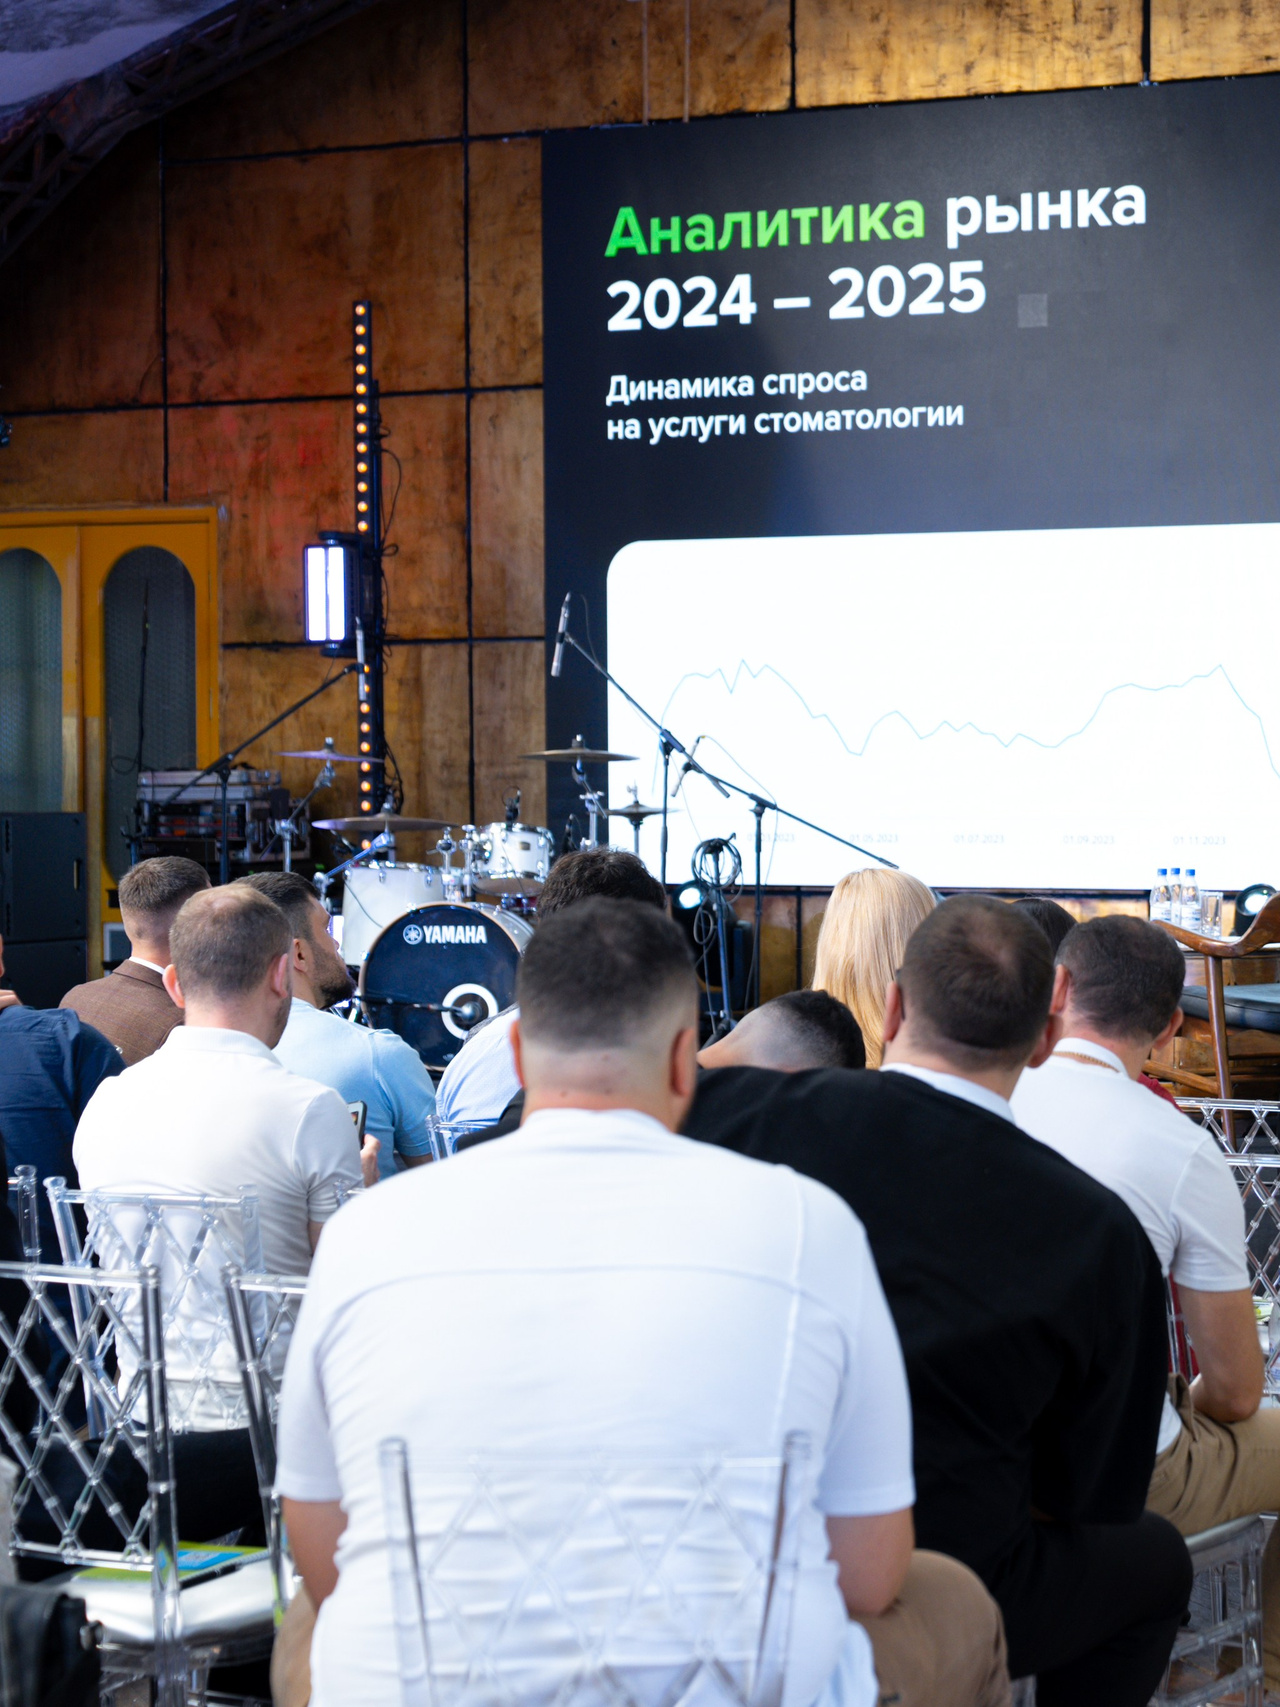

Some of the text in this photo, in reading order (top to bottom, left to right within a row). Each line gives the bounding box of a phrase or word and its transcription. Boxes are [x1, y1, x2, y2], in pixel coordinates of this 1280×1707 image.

[605, 184, 1147, 257] Аналитика рынка
[607, 274, 757, 332] 2024
[829, 260, 987, 320] 2025
[606, 369, 868, 406] Динамика спроса
[607, 397, 965, 444] на услуги стоматологии
[1173, 835, 1227, 847] 01.11.2023
[423, 925, 487, 944] YAMAHA
